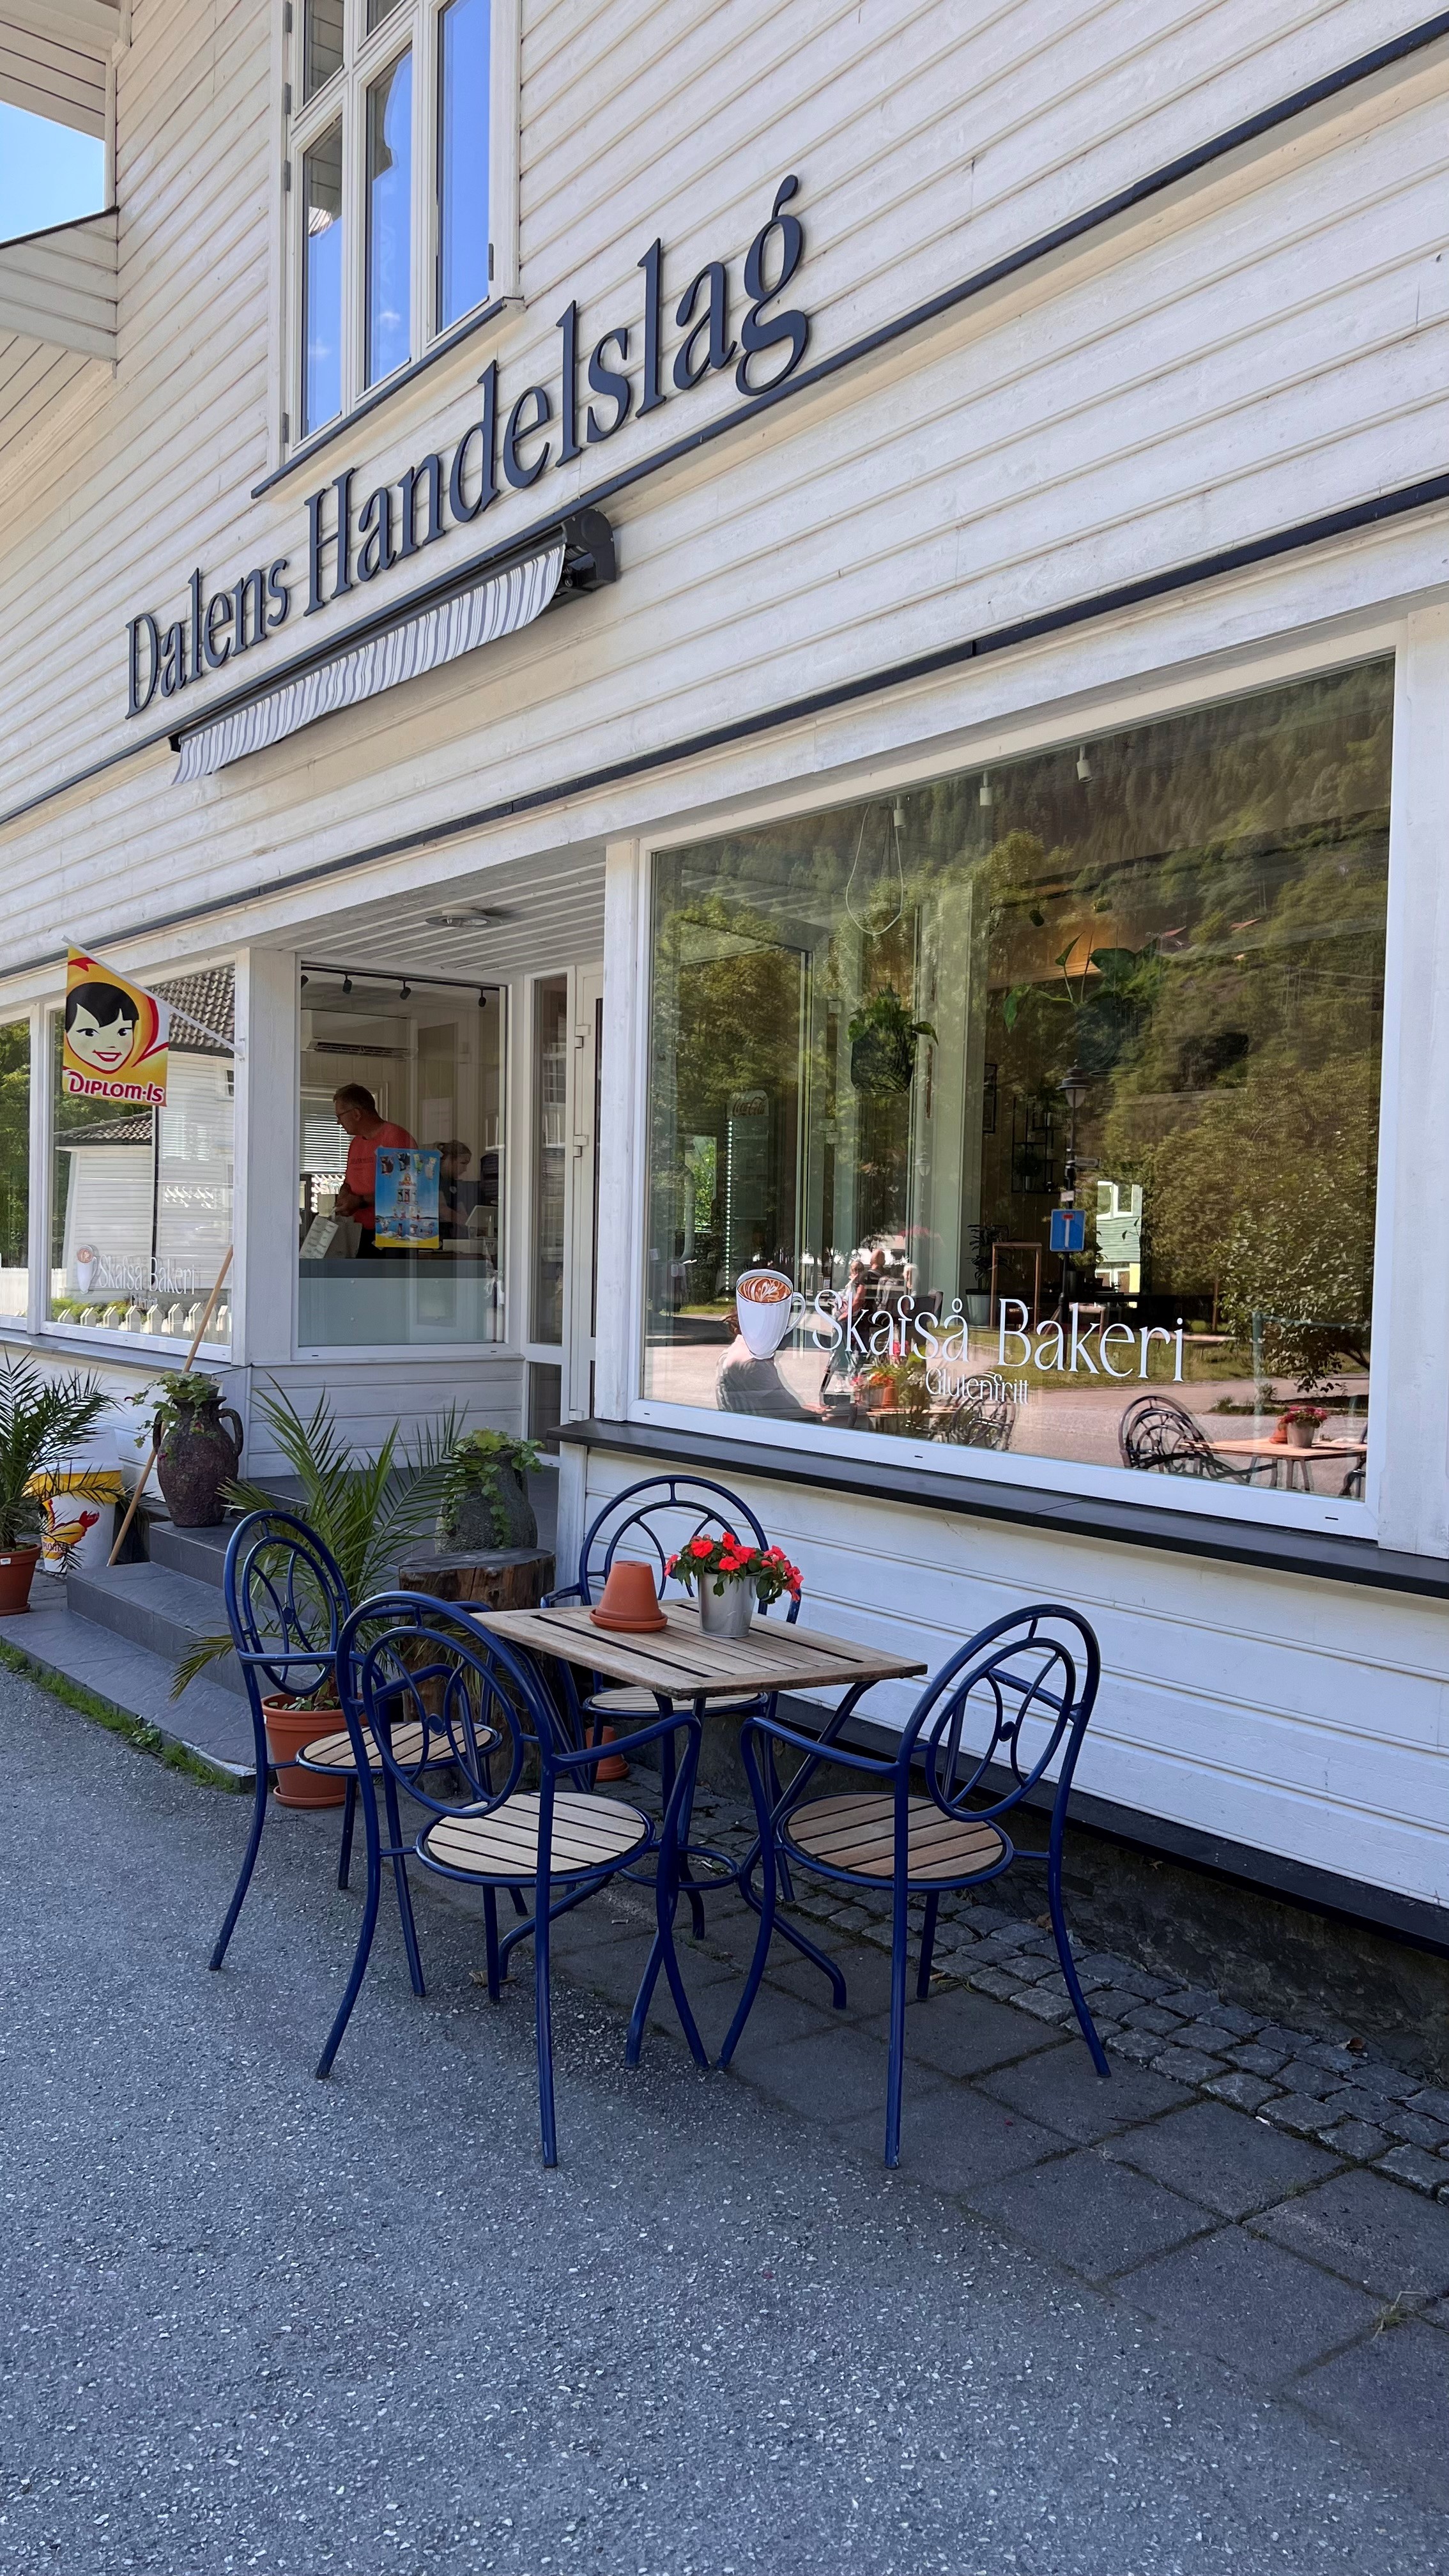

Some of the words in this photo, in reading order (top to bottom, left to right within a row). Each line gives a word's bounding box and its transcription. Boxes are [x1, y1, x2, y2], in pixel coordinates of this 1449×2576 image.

[126, 567, 289, 719] Dalens
[303, 174, 809, 618] Handelslag
[149, 1257, 195, 1294] Bakeri
[813, 1289, 970, 1362] Skafså
[997, 1298, 1184, 1382] Bakeri
[926, 1367, 1029, 1405] Glutenfritt
